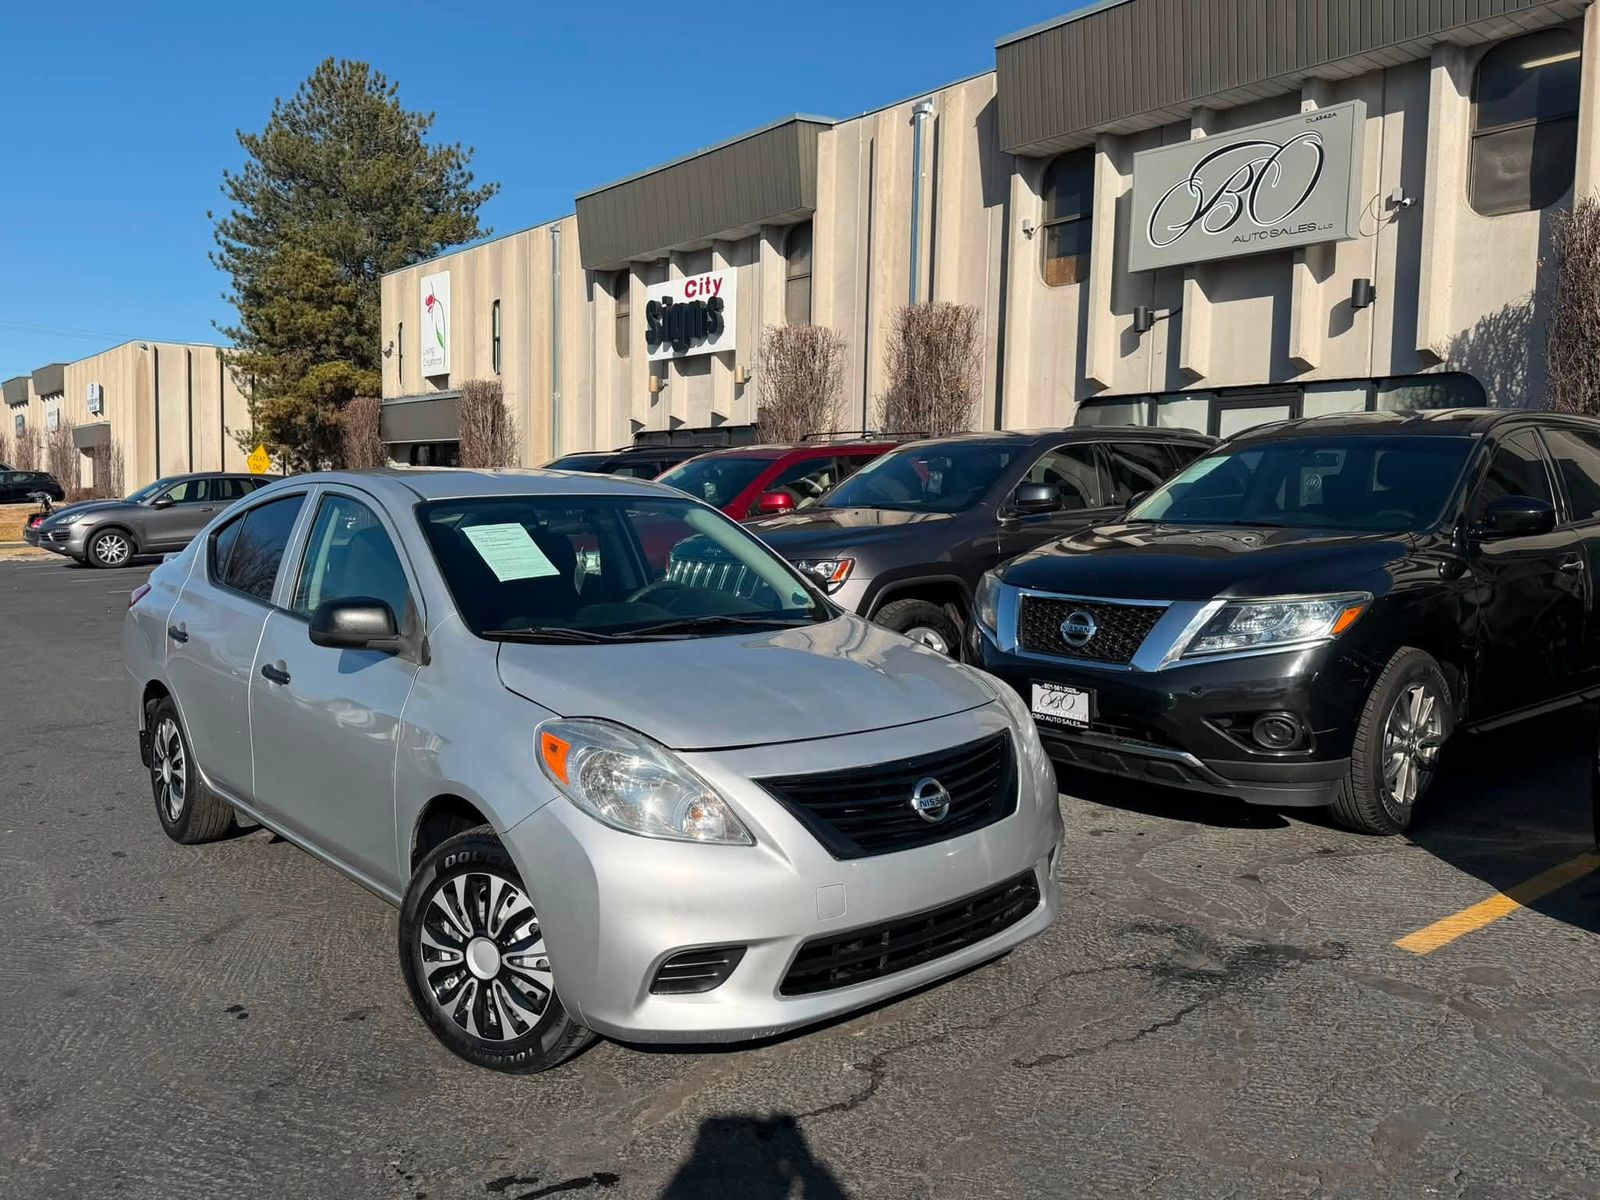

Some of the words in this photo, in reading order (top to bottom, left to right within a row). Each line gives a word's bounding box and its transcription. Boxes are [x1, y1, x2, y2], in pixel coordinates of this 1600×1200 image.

[1232, 231, 1269, 244] AUTO
[1269, 222, 1317, 238] SALES
[684, 276, 723, 298] City
[1045, 716, 1062, 724] AUTO
[1062, 719, 1081, 727] SALES
